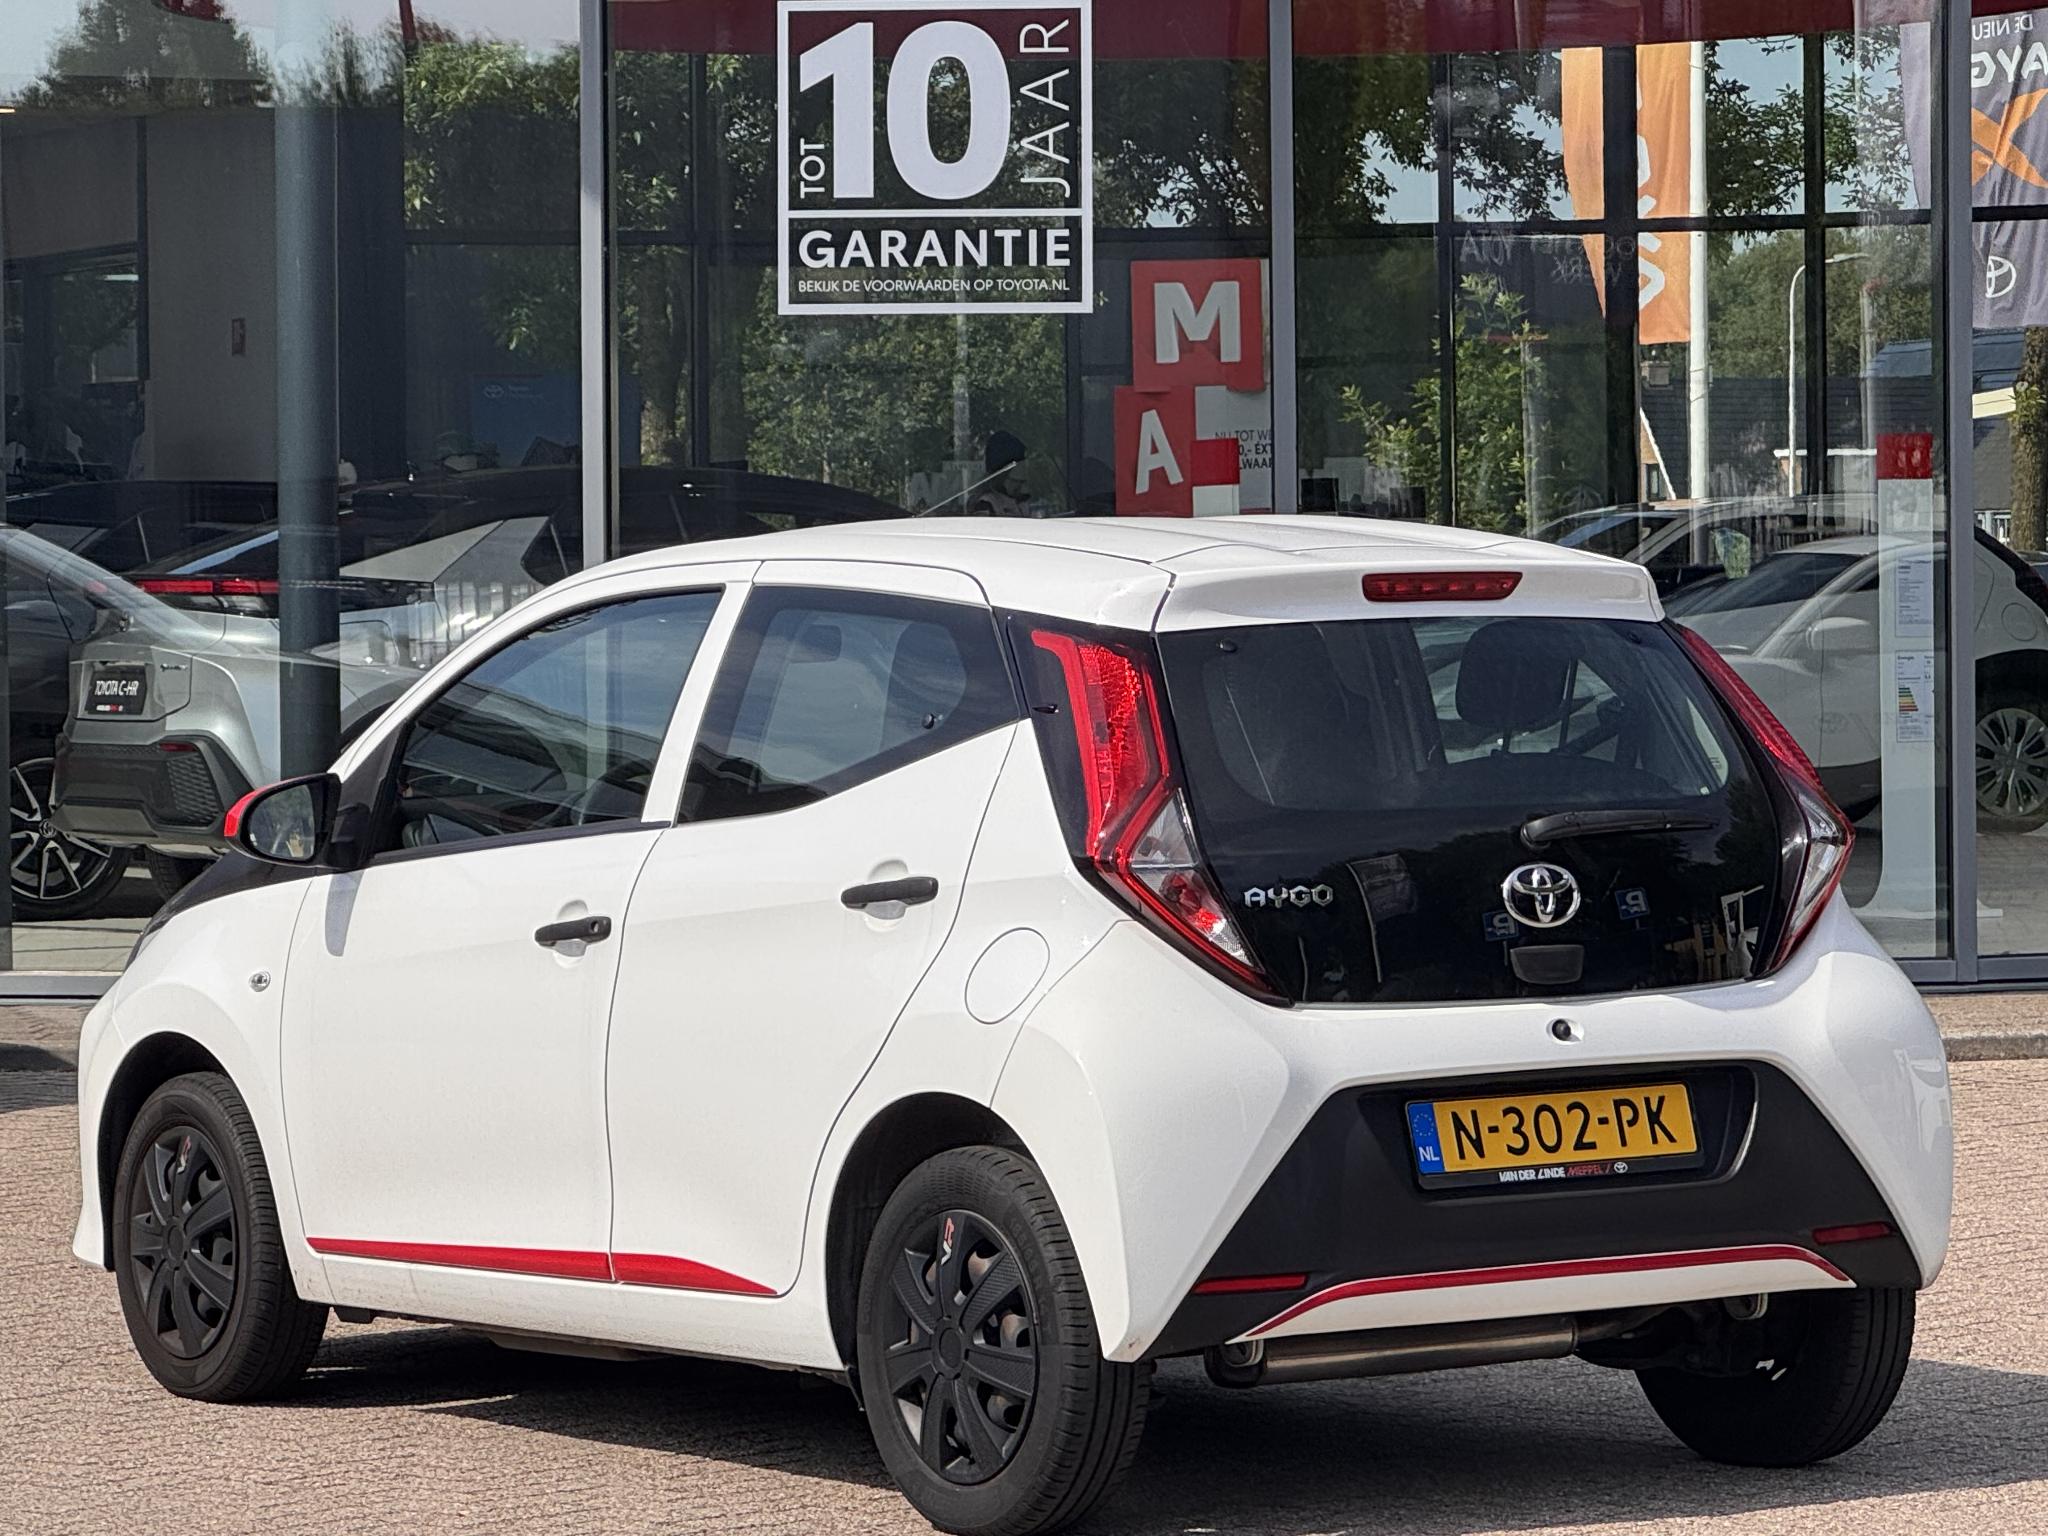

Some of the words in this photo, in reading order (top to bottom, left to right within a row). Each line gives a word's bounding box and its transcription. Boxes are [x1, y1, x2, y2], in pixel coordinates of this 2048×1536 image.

[800, 20, 1011, 200] 10
[1019, 18, 1071, 198] JAAR
[800, 138, 825, 199] TOT
[798, 228, 1071, 268] GARANTIE
[798, 279, 840, 292] BEKIJK
[842, 279, 861, 292] DE
[863, 279, 970, 292] VOORWAARDEN
[973, 279, 994, 292] OP
[996, 278, 1070, 291] TOYOTA.NL
[1153, 281, 1242, 364] M
[1135, 409, 1184, 495] A
[1243, 883, 1334, 908] AYGO
[1418, 1145, 1440, 1162] NL
[1451, 1095, 1678, 1161] N-302-PK
[1499, 1171, 1518, 1182] VAN
[1519, 1169, 1536, 1181] DER
[1538, 1166, 1565, 1180] LINDE
